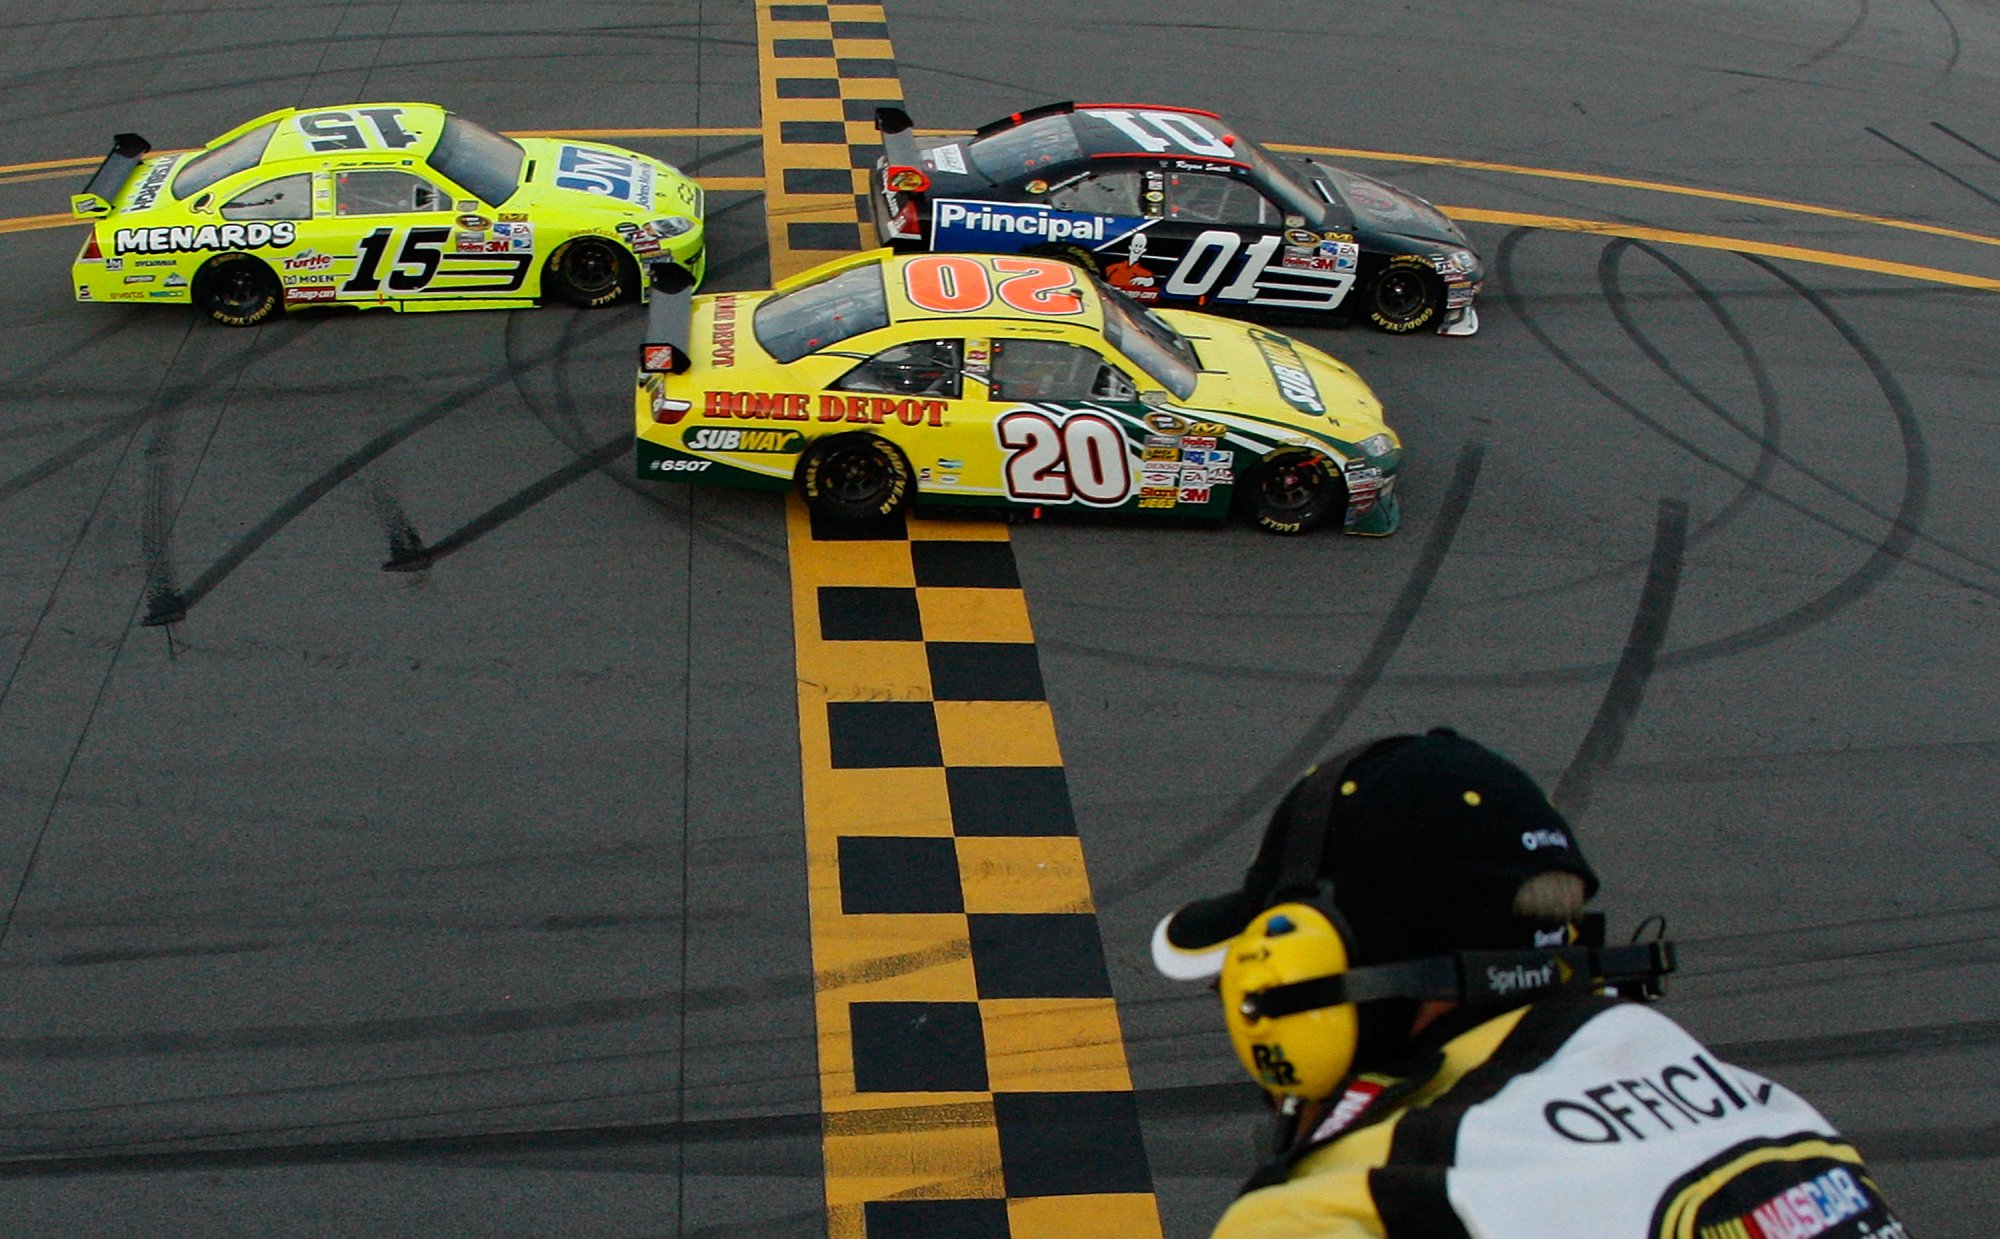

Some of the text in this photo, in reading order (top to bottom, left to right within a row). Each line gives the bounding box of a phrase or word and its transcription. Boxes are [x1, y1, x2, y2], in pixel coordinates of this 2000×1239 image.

[295, 108, 419, 151] 15
[1087, 111, 1235, 158] 01
[116, 223, 296, 254] MENARDS
[941, 205, 1104, 242] Principal
[284, 254, 331, 270] Turtle
[340, 226, 452, 293] 15
[486, 241, 509, 252] 3M
[300, 275, 334, 283] MOEN
[1165, 231, 1281, 300] 01
[1312, 258, 1333, 270] 3M
[286, 289, 335, 300] Snap-on
[904, 254, 1084, 315] 20
[703, 391, 948, 427] HOME DEPOT
[689, 430, 798, 450] SUBWAY
[650, 460, 712, 472] #6507
[998, 409, 1131, 505] 20
[1180, 488, 1209, 502] 3M
[1486, 962, 1553, 994] Sprint
[1751, 1166, 1870, 1239] NASCAR
